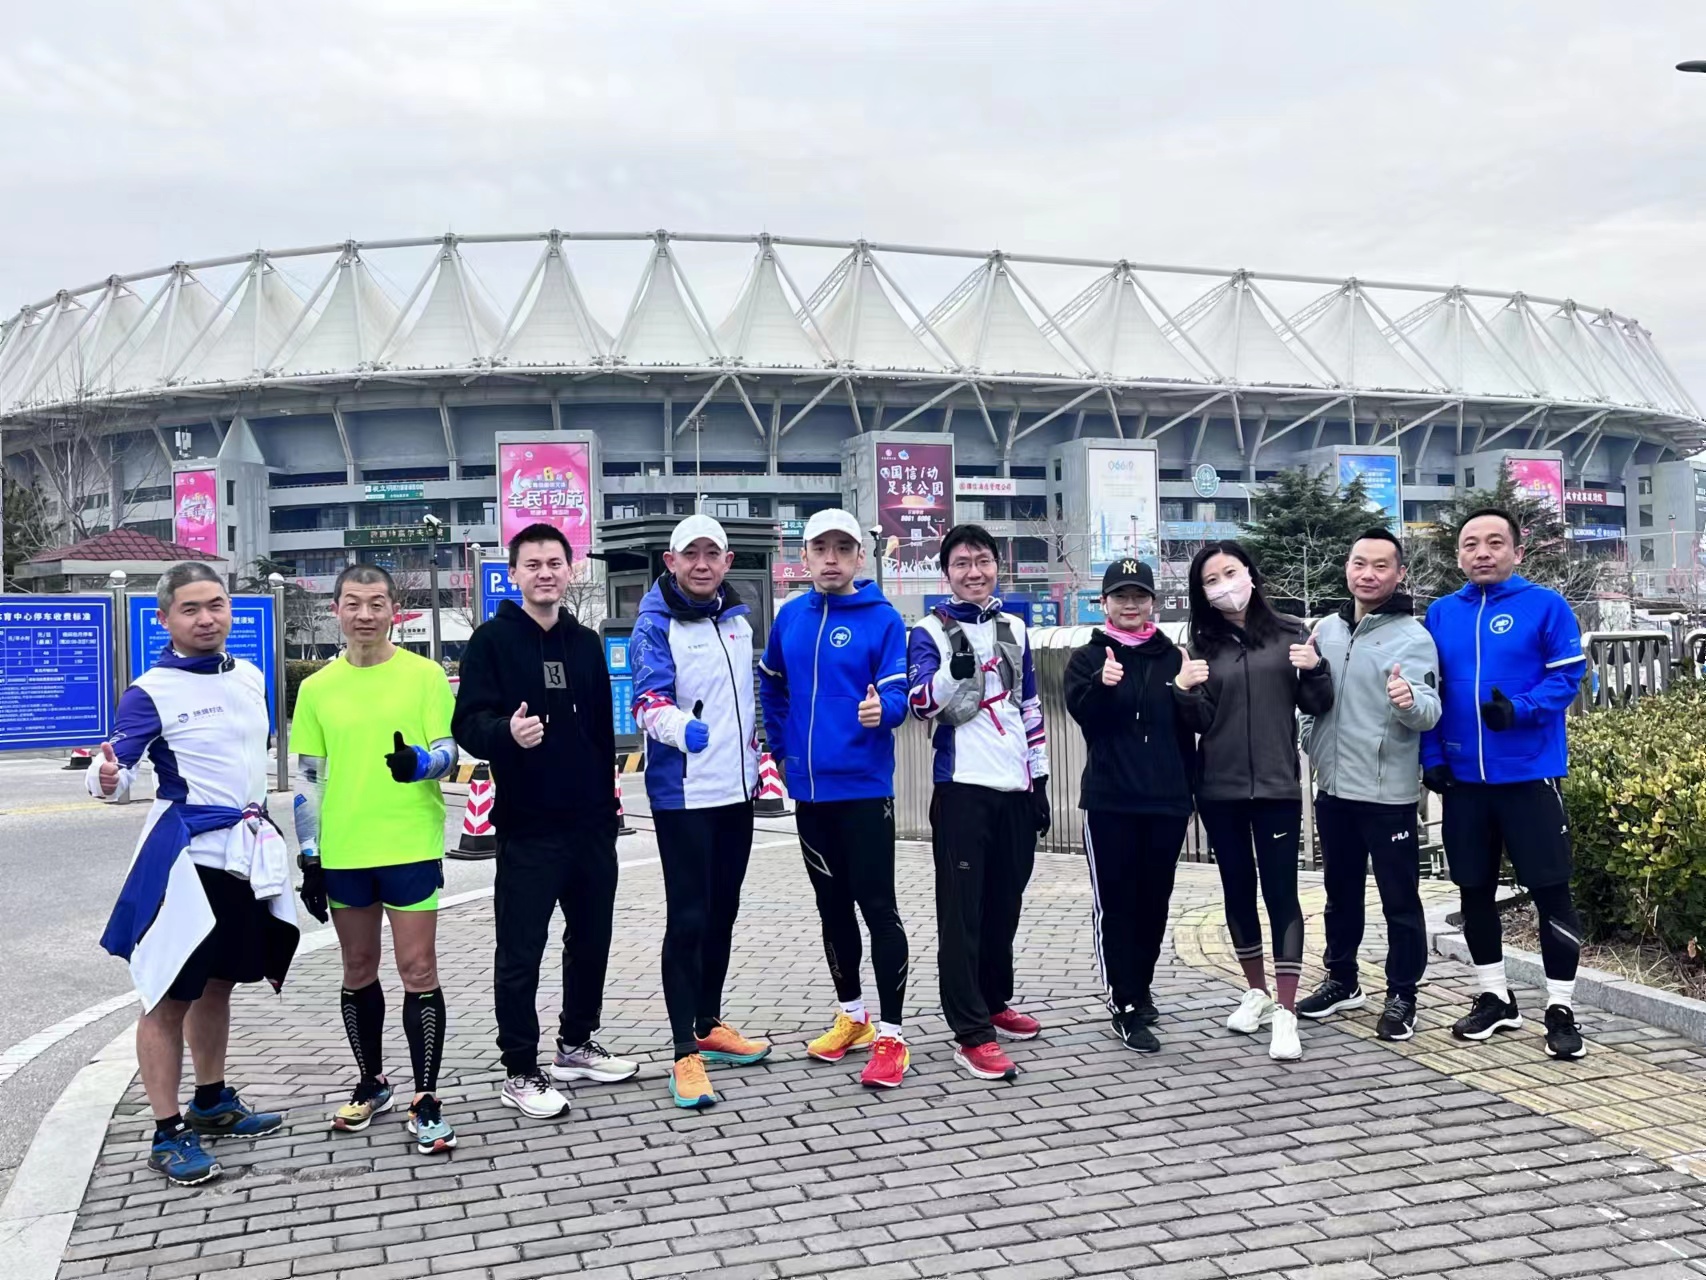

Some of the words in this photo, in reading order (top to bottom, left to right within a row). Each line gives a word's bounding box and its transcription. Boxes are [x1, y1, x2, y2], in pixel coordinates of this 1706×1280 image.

[887, 481, 944, 496] 足球公园
[1122, 560, 1137, 574] NY
[490, 572, 502, 593] P
[0, 612, 91, 621] 育中心停车收费标准
[1391, 830, 1410, 842] FILA
